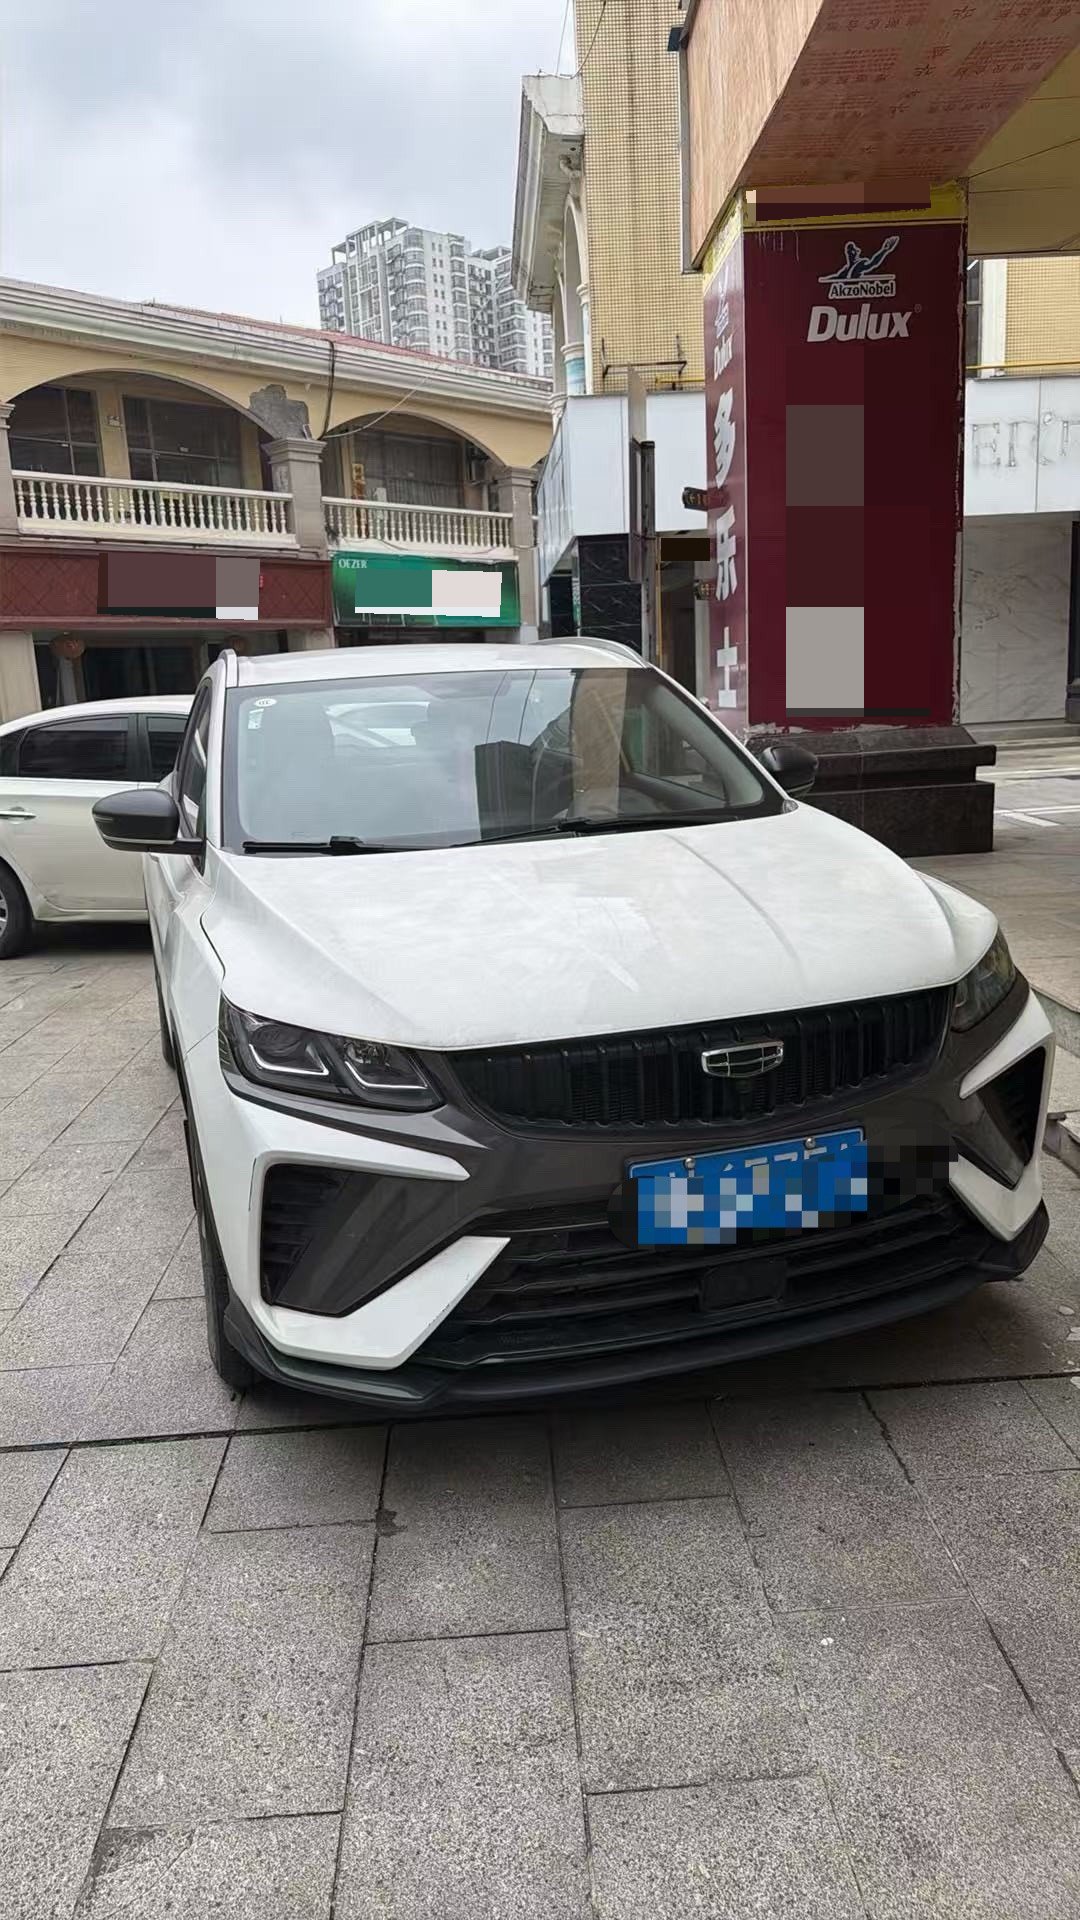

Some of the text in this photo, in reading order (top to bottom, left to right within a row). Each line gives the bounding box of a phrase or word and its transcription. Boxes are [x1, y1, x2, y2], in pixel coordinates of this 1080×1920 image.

[830, 281, 895, 298] AkzoNobel
[807, 303, 912, 342] Dulux
[713, 387, 738, 708] 多乐士
